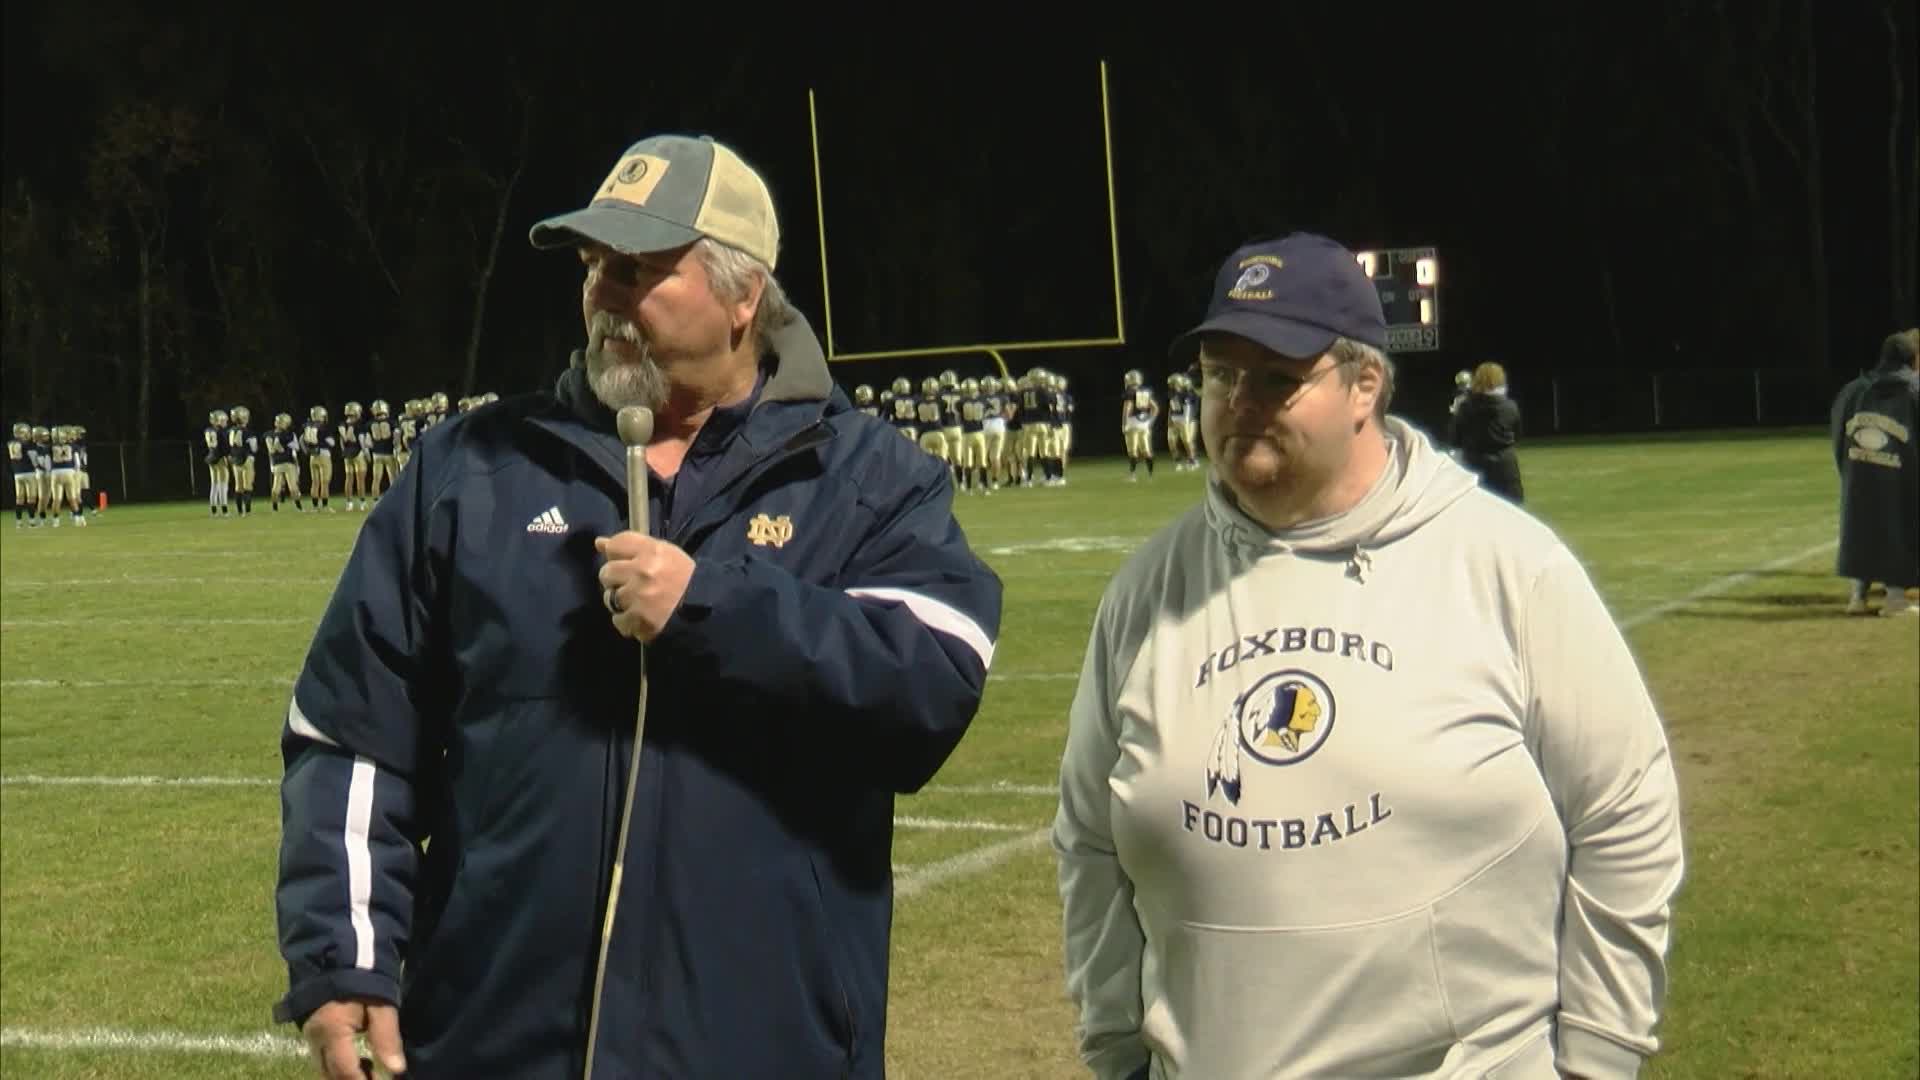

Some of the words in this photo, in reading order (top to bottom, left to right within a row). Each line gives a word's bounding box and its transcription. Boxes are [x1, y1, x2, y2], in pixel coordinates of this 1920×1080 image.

[526, 521, 569, 534] adidas
[1195, 627, 1394, 688] FOXBORO
[1182, 792, 1392, 850] FOOTBALL
